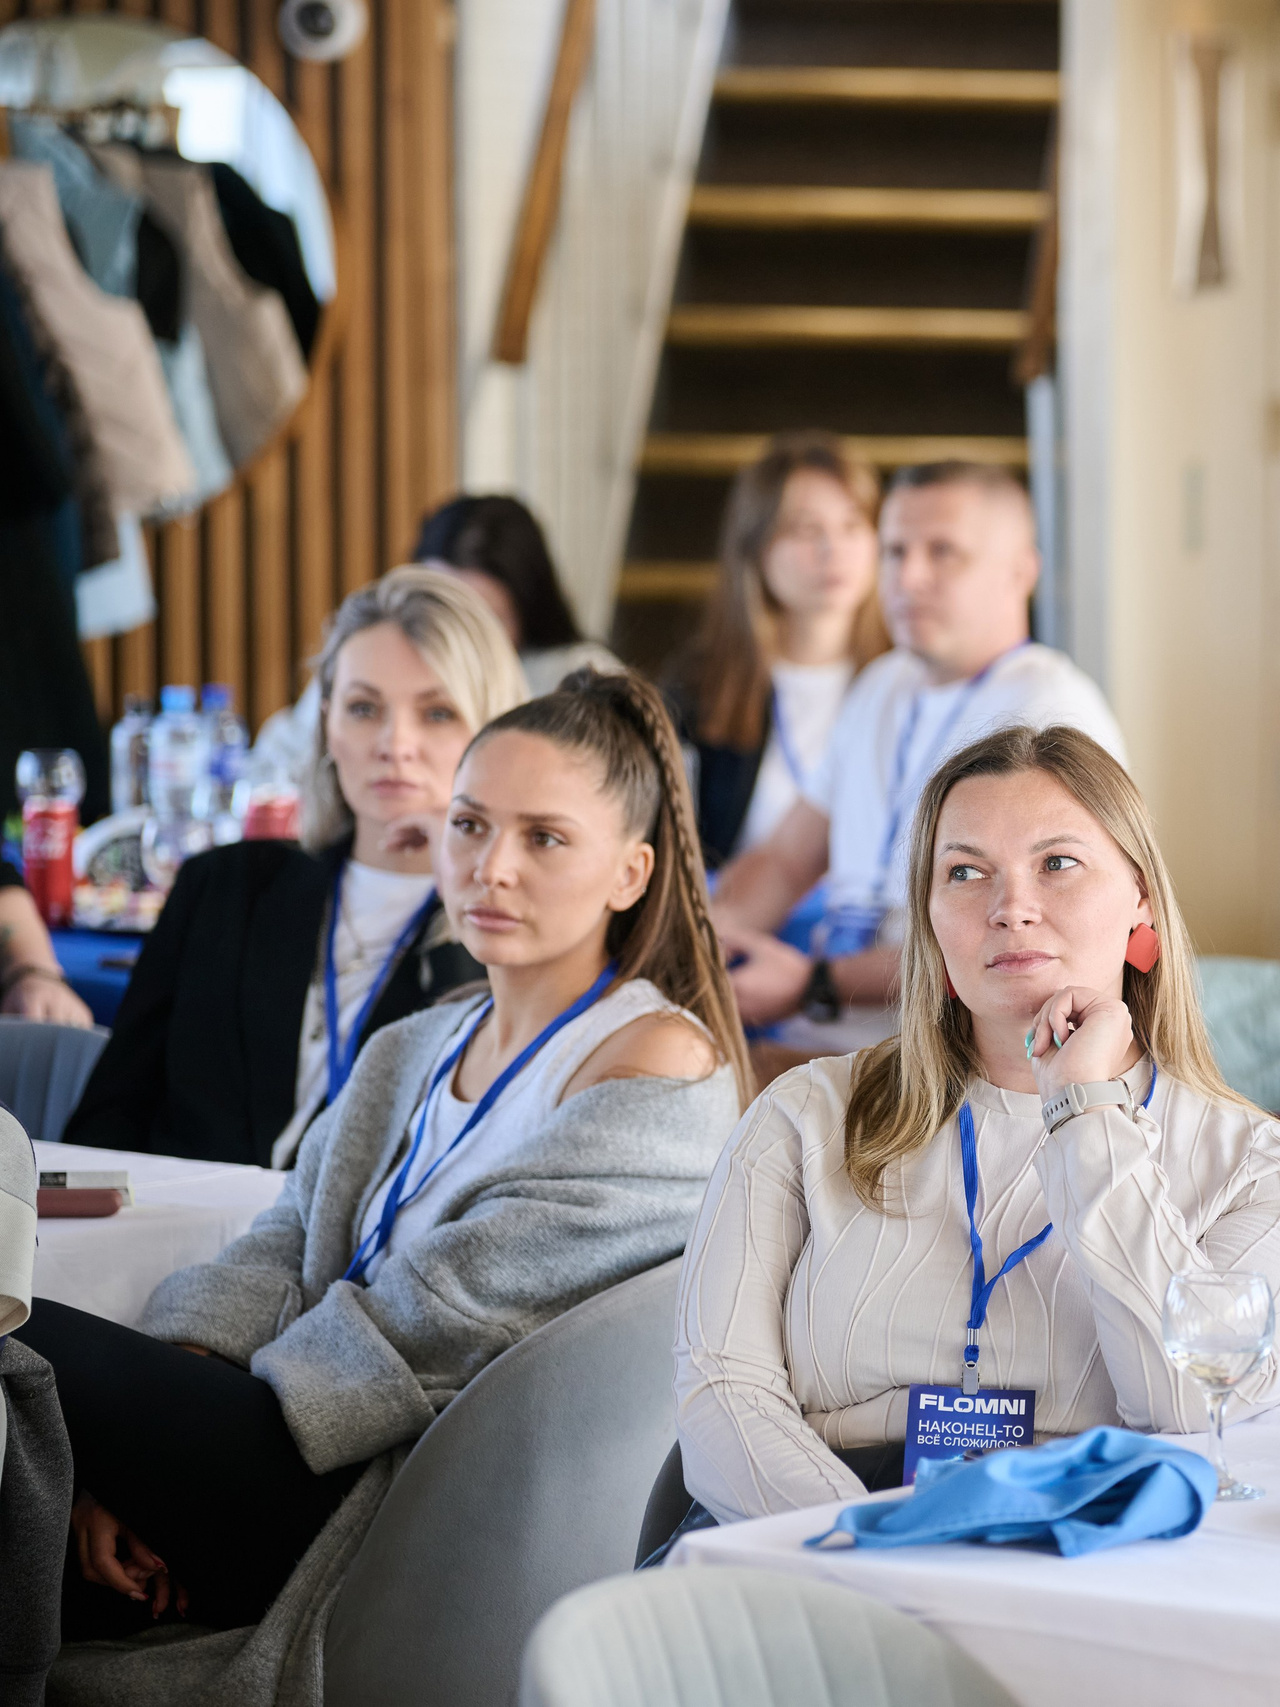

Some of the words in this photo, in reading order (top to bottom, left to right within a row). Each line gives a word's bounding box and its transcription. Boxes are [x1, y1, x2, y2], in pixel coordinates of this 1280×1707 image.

[919, 1393, 1026, 1415] FLOMNI
[918, 1419, 1025, 1438] НАКОНЕЦ-ТО
[917, 1434, 941, 1446] ВСЁ
